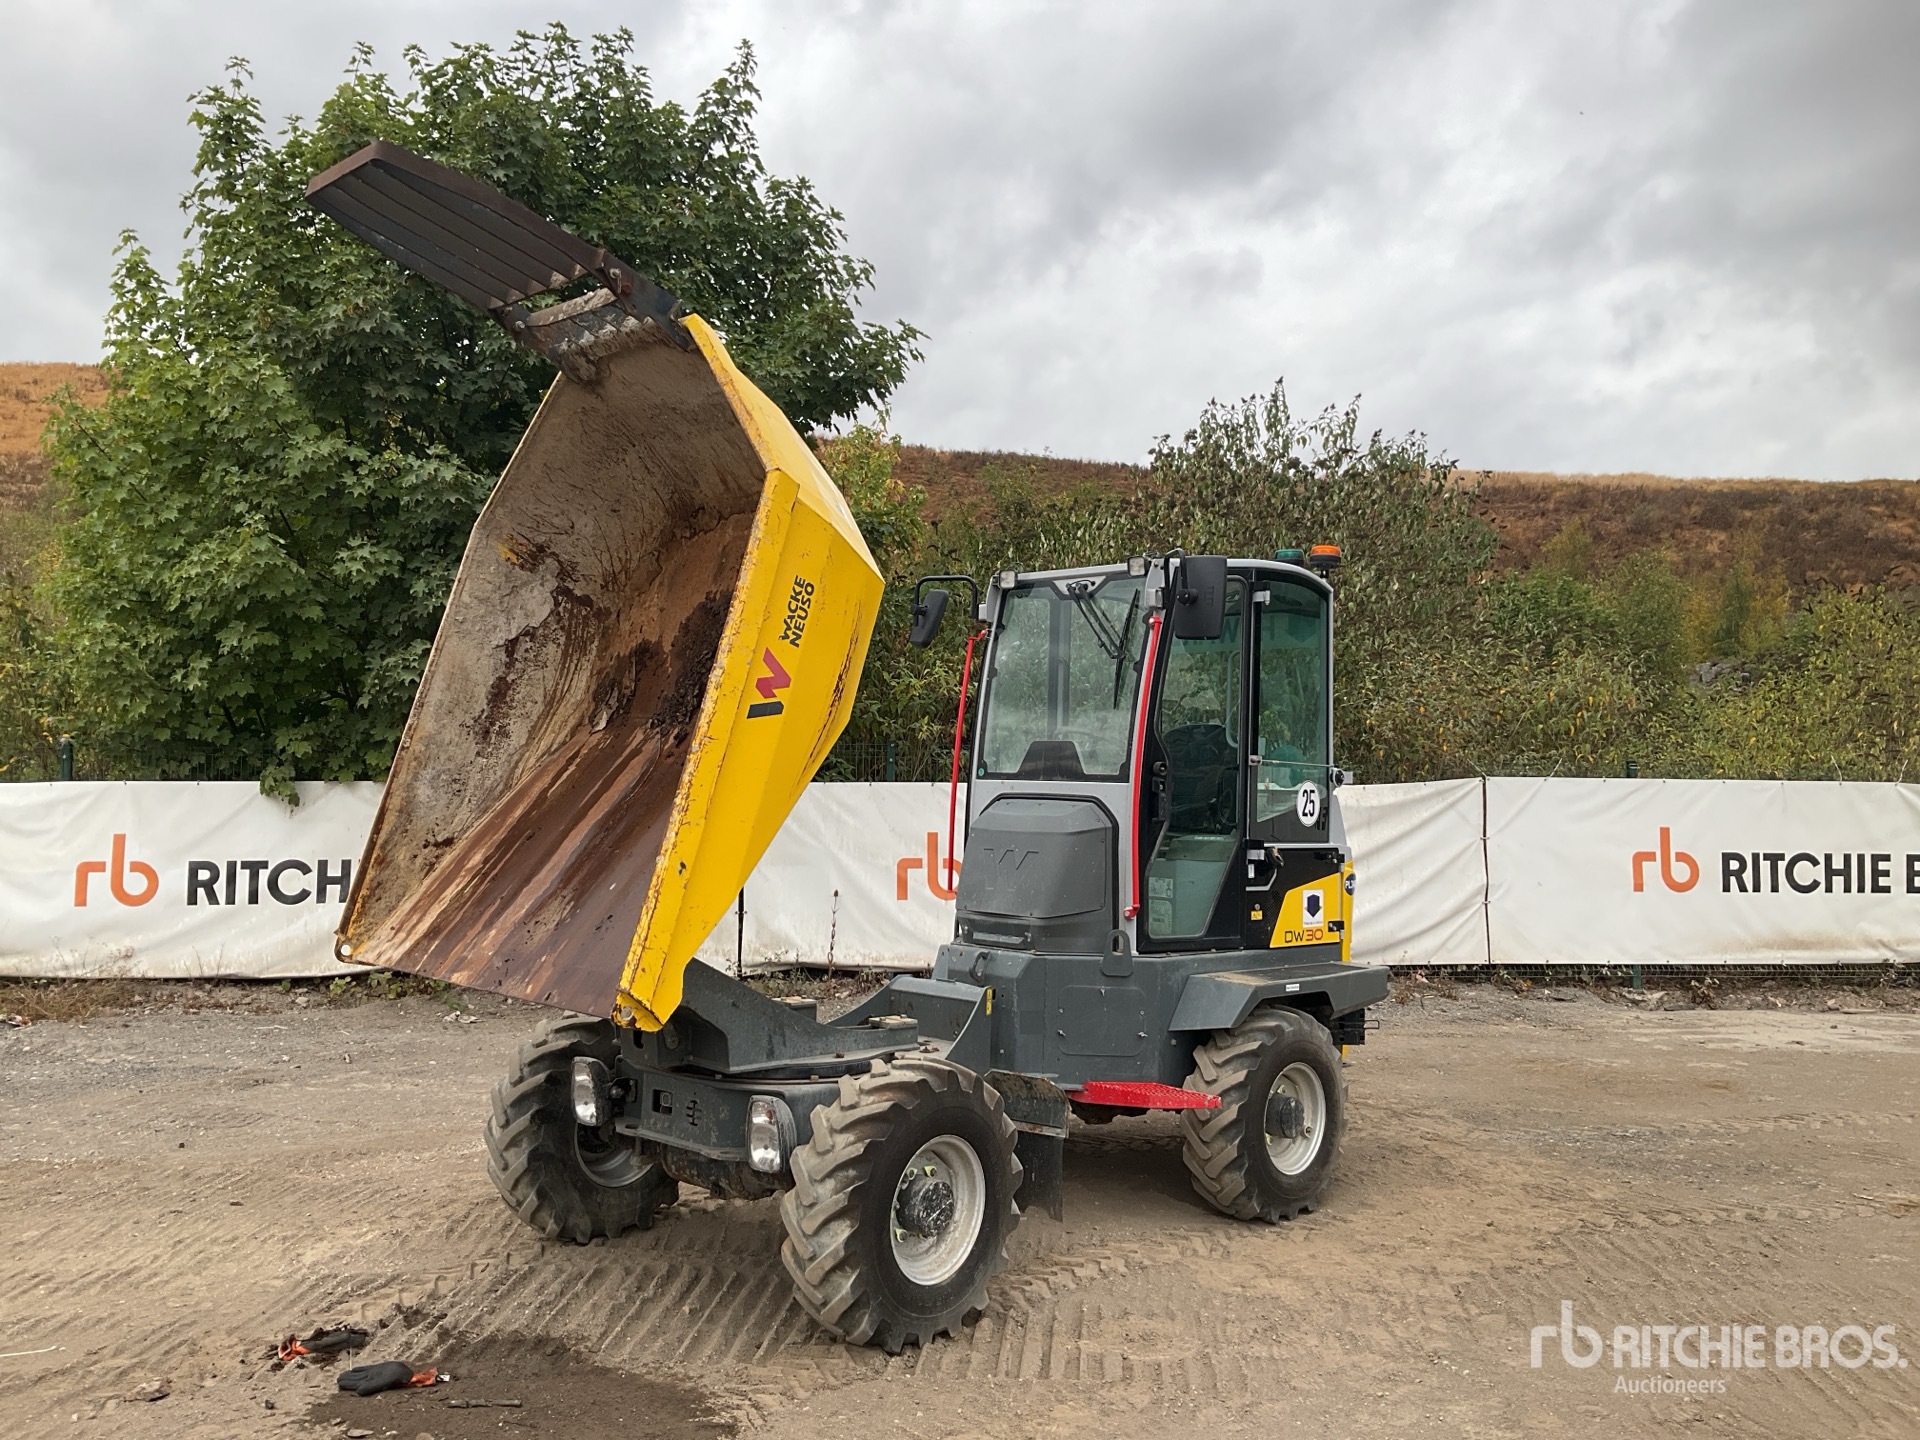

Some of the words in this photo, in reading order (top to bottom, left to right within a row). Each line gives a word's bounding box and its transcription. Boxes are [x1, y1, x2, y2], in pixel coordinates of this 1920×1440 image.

[1301, 788, 1316, 818] 25
[74, 834, 159, 907] rb
[186, 859, 358, 906] RITCH
[1632, 827, 1699, 893] rb
[1721, 852, 1892, 894] RITCHIE
[1284, 928, 1324, 944] DW30
